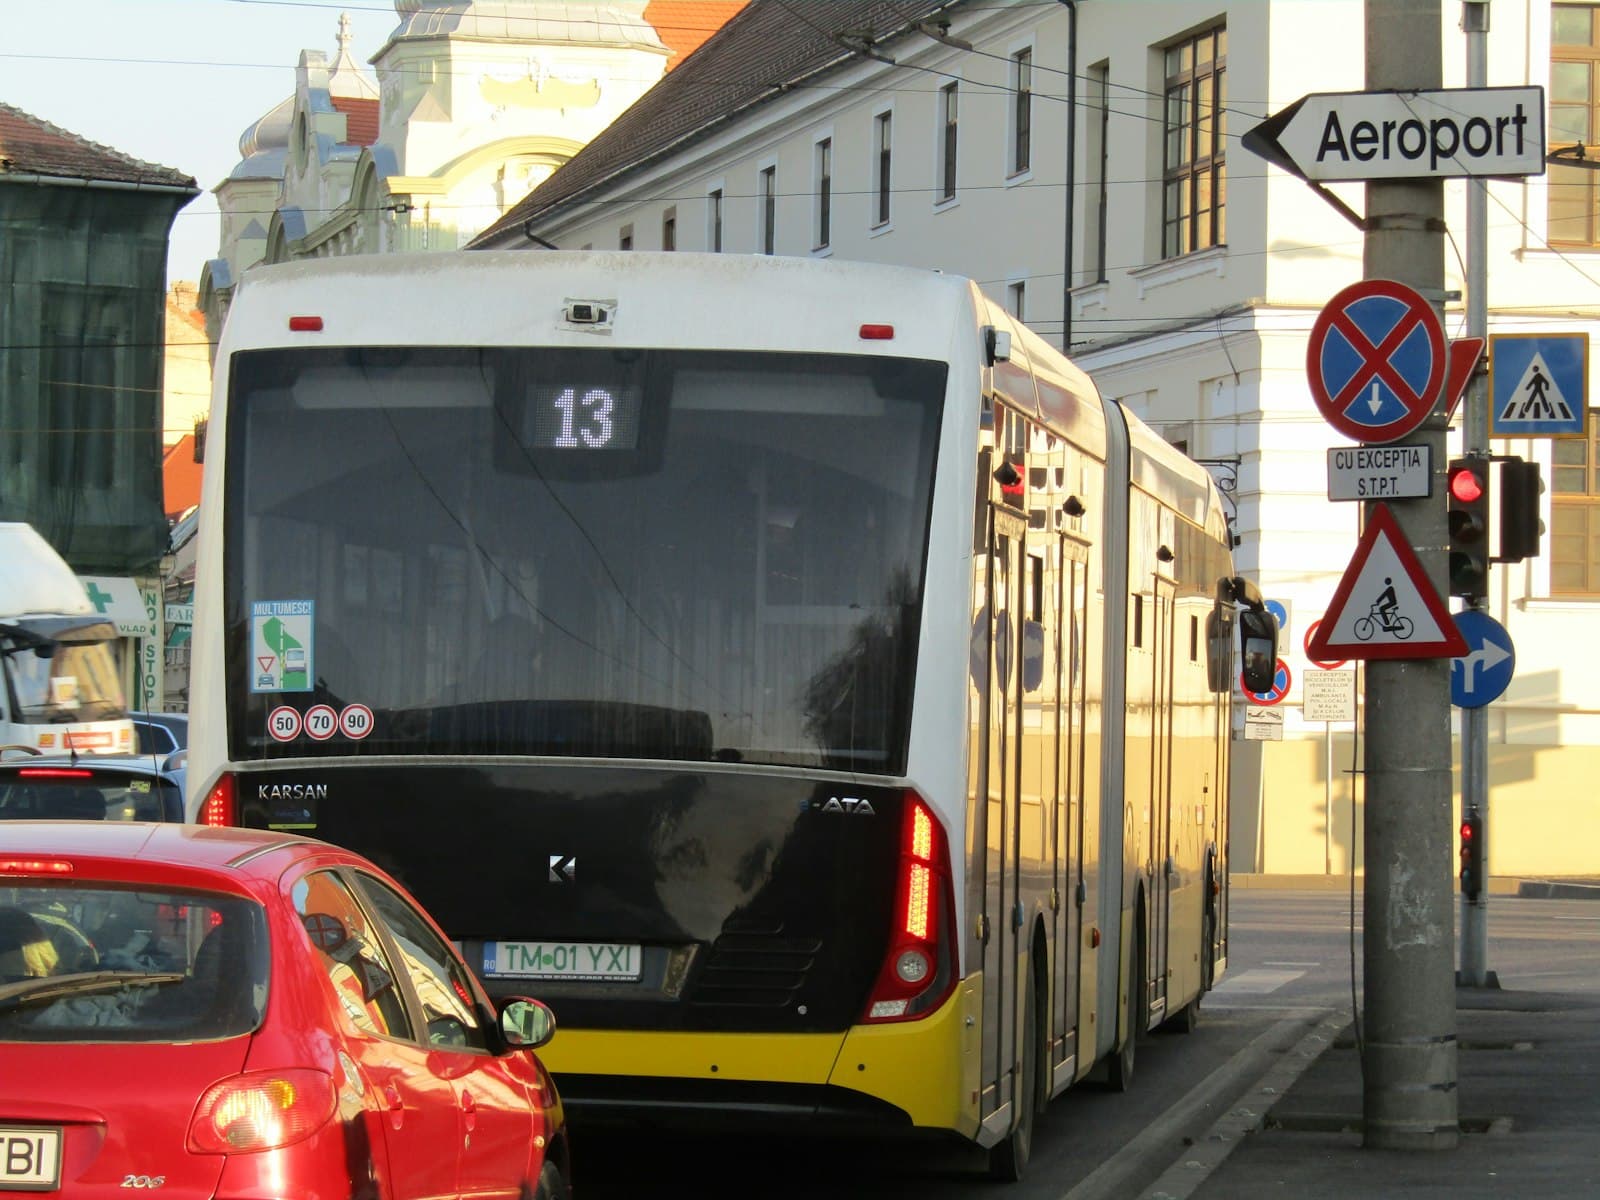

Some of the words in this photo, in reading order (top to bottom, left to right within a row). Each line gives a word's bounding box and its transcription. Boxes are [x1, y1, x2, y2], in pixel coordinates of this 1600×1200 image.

[1315, 103, 1528, 171] Aeroport
[554, 388, 613, 447] 13
[1335, 451, 1354, 470] CU
[1358, 477, 1400, 496] S.T.P.T.
[119, 624, 146, 633] VLAD
[276, 717, 294, 731] 50
[312, 715, 330, 729] 70
[347, 714, 365, 728] 90
[258, 784, 328, 800] KARSAN
[483, 959, 496, 970] RO
[586, 945, 632, 972] YXI
[119, 1174, 166, 1189] 206
